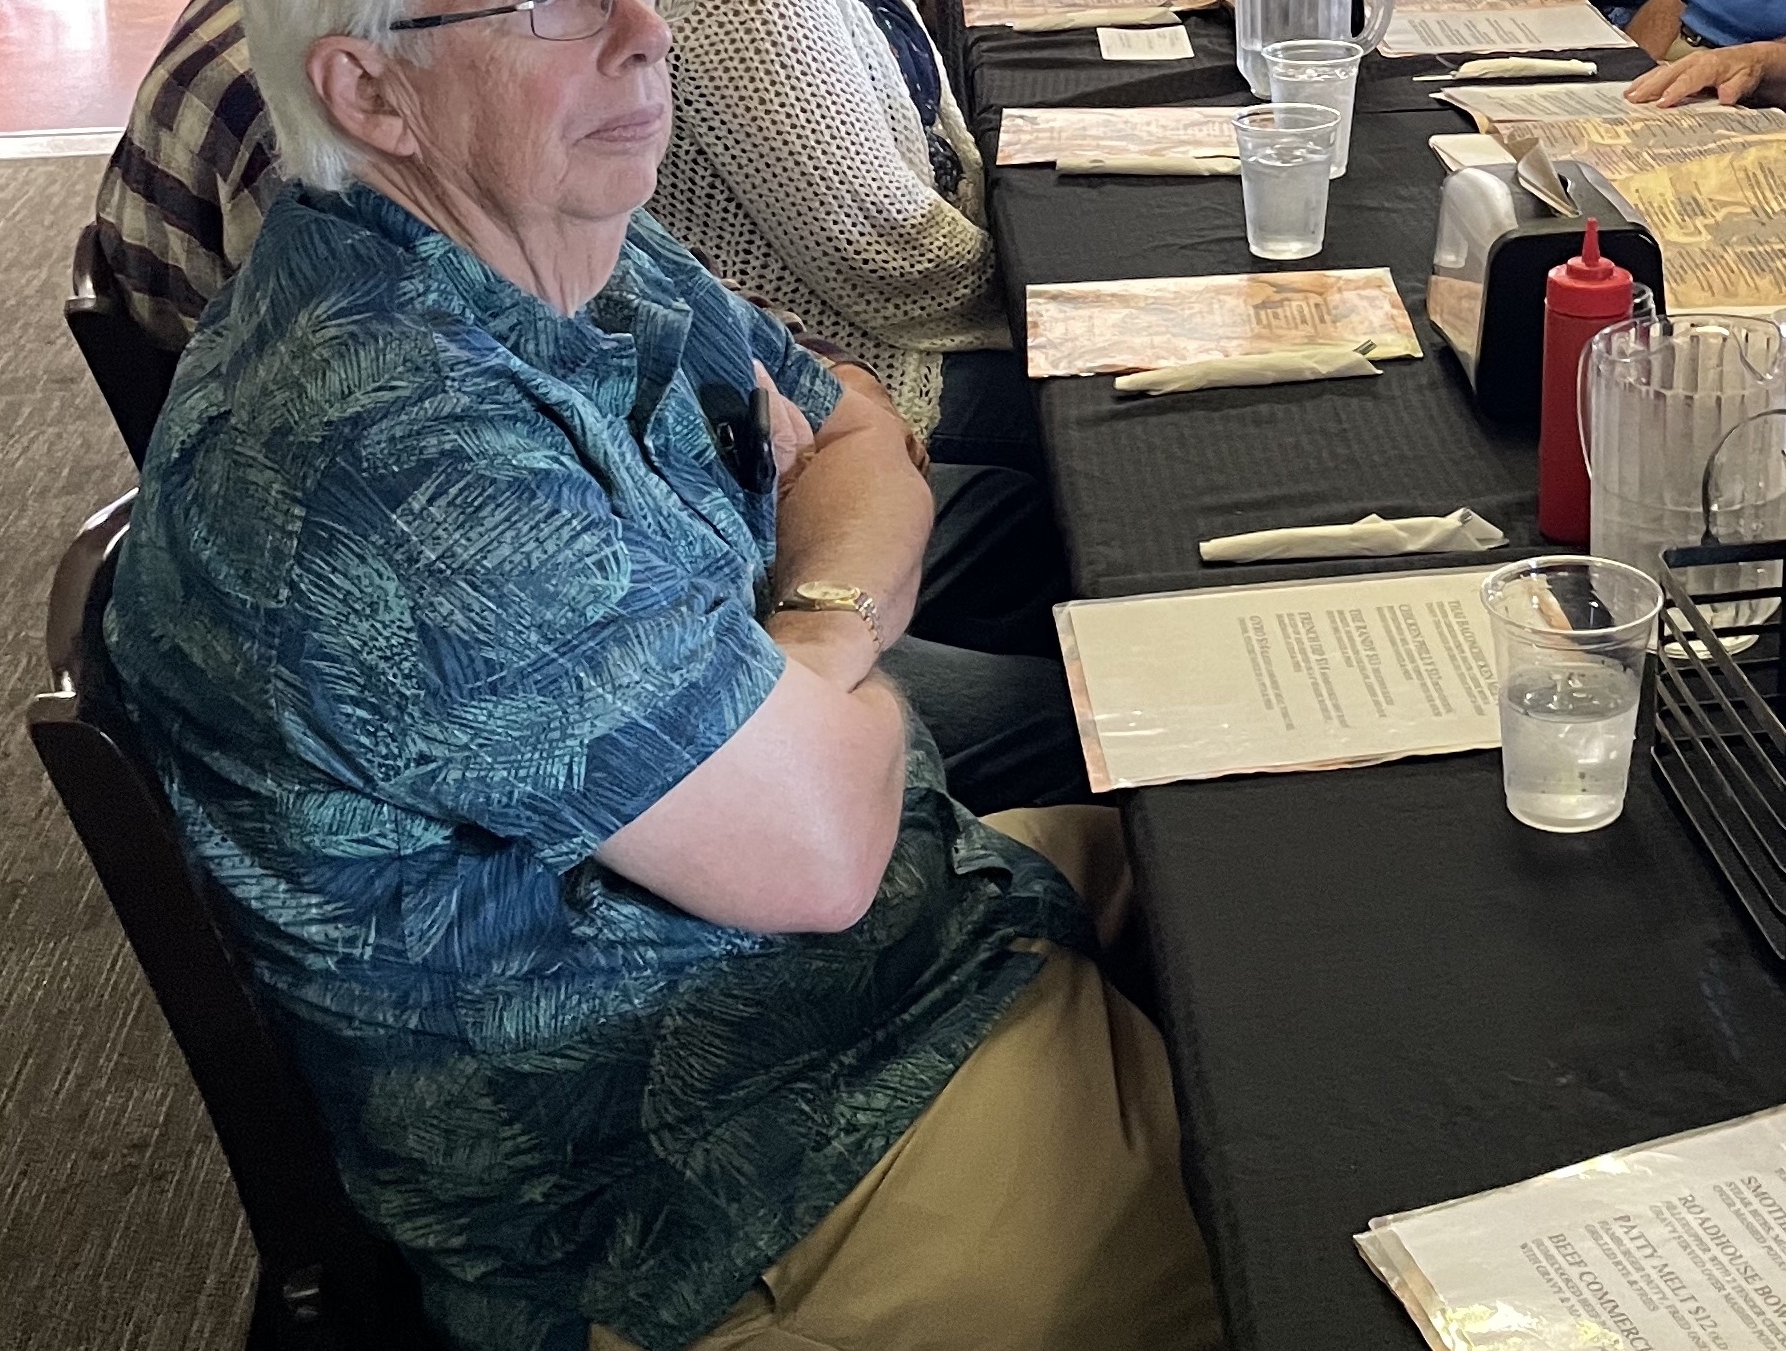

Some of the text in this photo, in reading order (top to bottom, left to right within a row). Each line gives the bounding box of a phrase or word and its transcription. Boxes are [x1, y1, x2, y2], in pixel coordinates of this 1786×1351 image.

[1543, 1232, 1589, 1271] BEEF
[1609, 1213, 1665, 1263] PATTY
[1649, 1261, 1701, 1307] MELT
[1685, 1304, 1723, 1332] $12
[1673, 1193, 1767, 1285] ROADHOUSE
